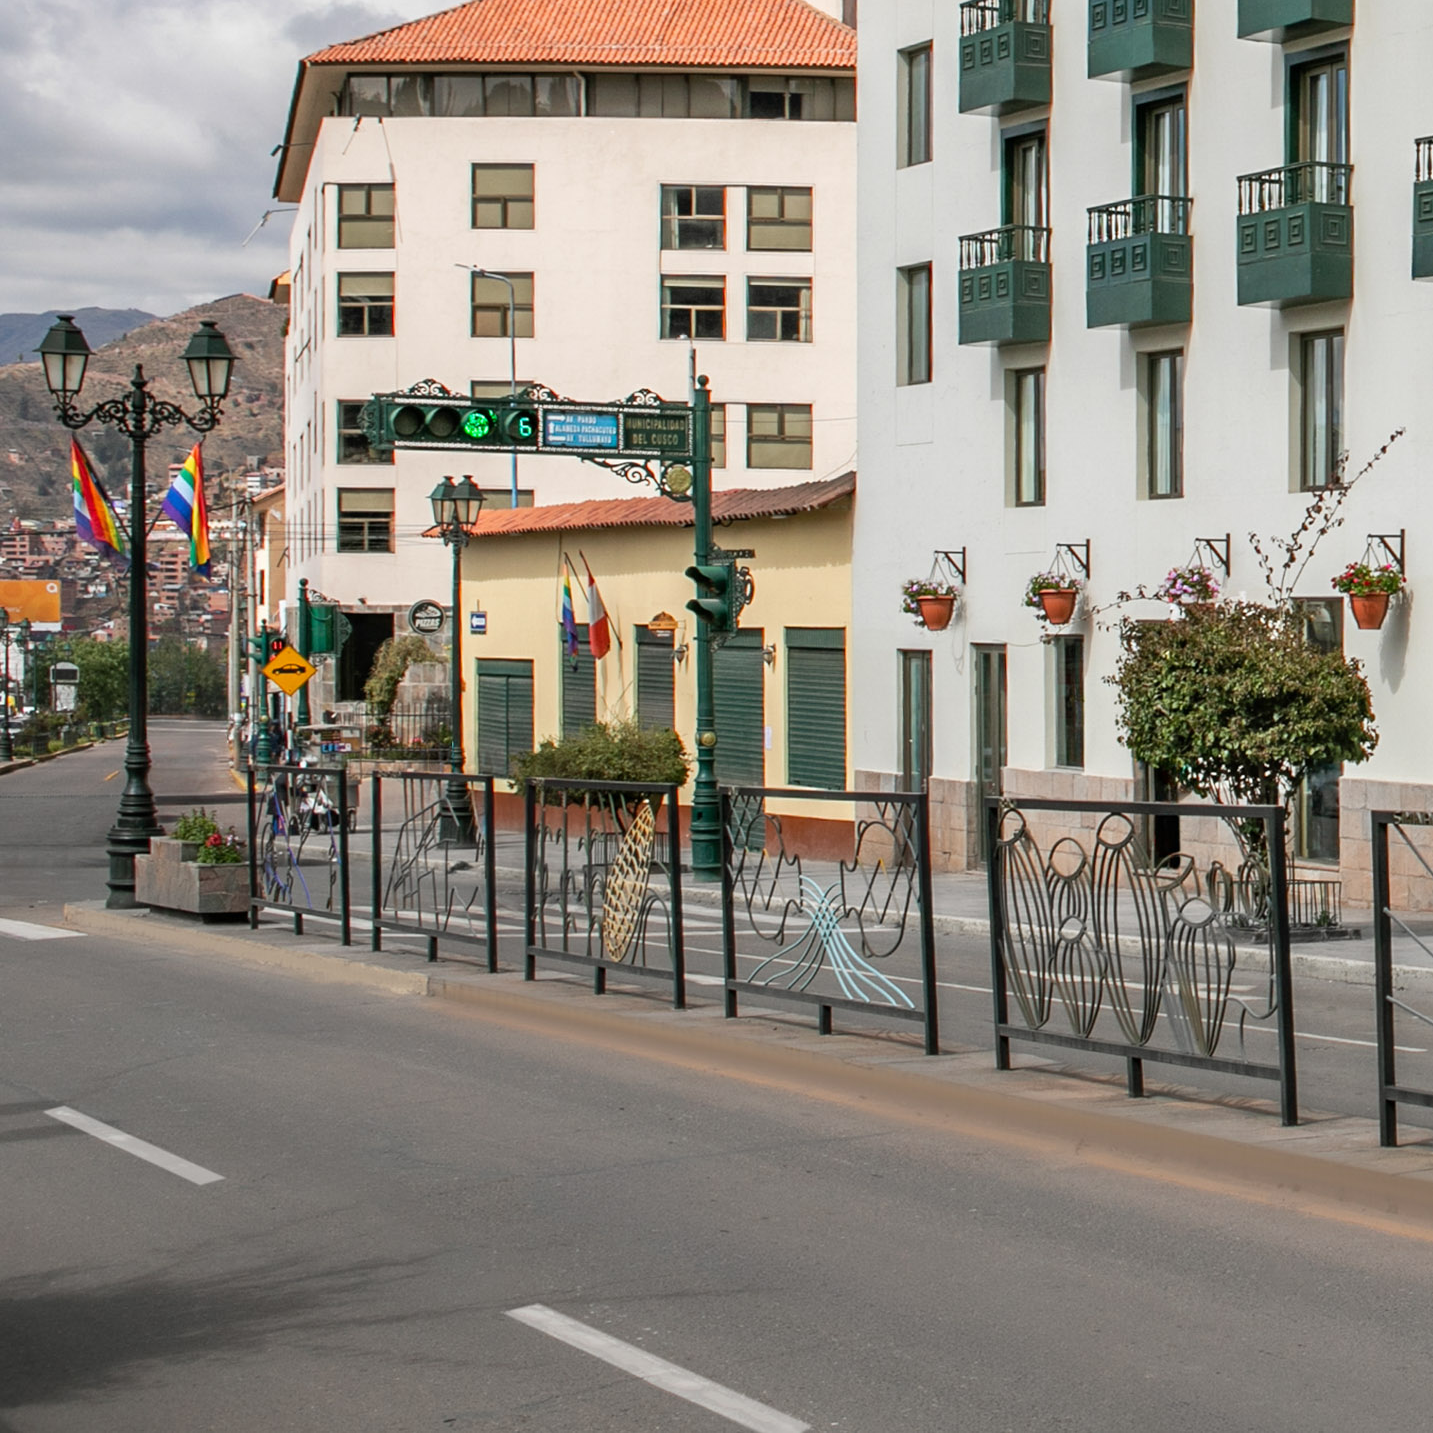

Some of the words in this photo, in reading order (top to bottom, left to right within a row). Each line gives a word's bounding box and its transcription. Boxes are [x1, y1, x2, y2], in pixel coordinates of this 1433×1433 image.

[519, 417, 532, 437] 6
[625, 417, 685, 431] MUNICIPALIDAD
[632, 433, 648, 445] DEL
[651, 433, 678, 445] CUSCO
[415, 618, 440, 628] PIZZAS
